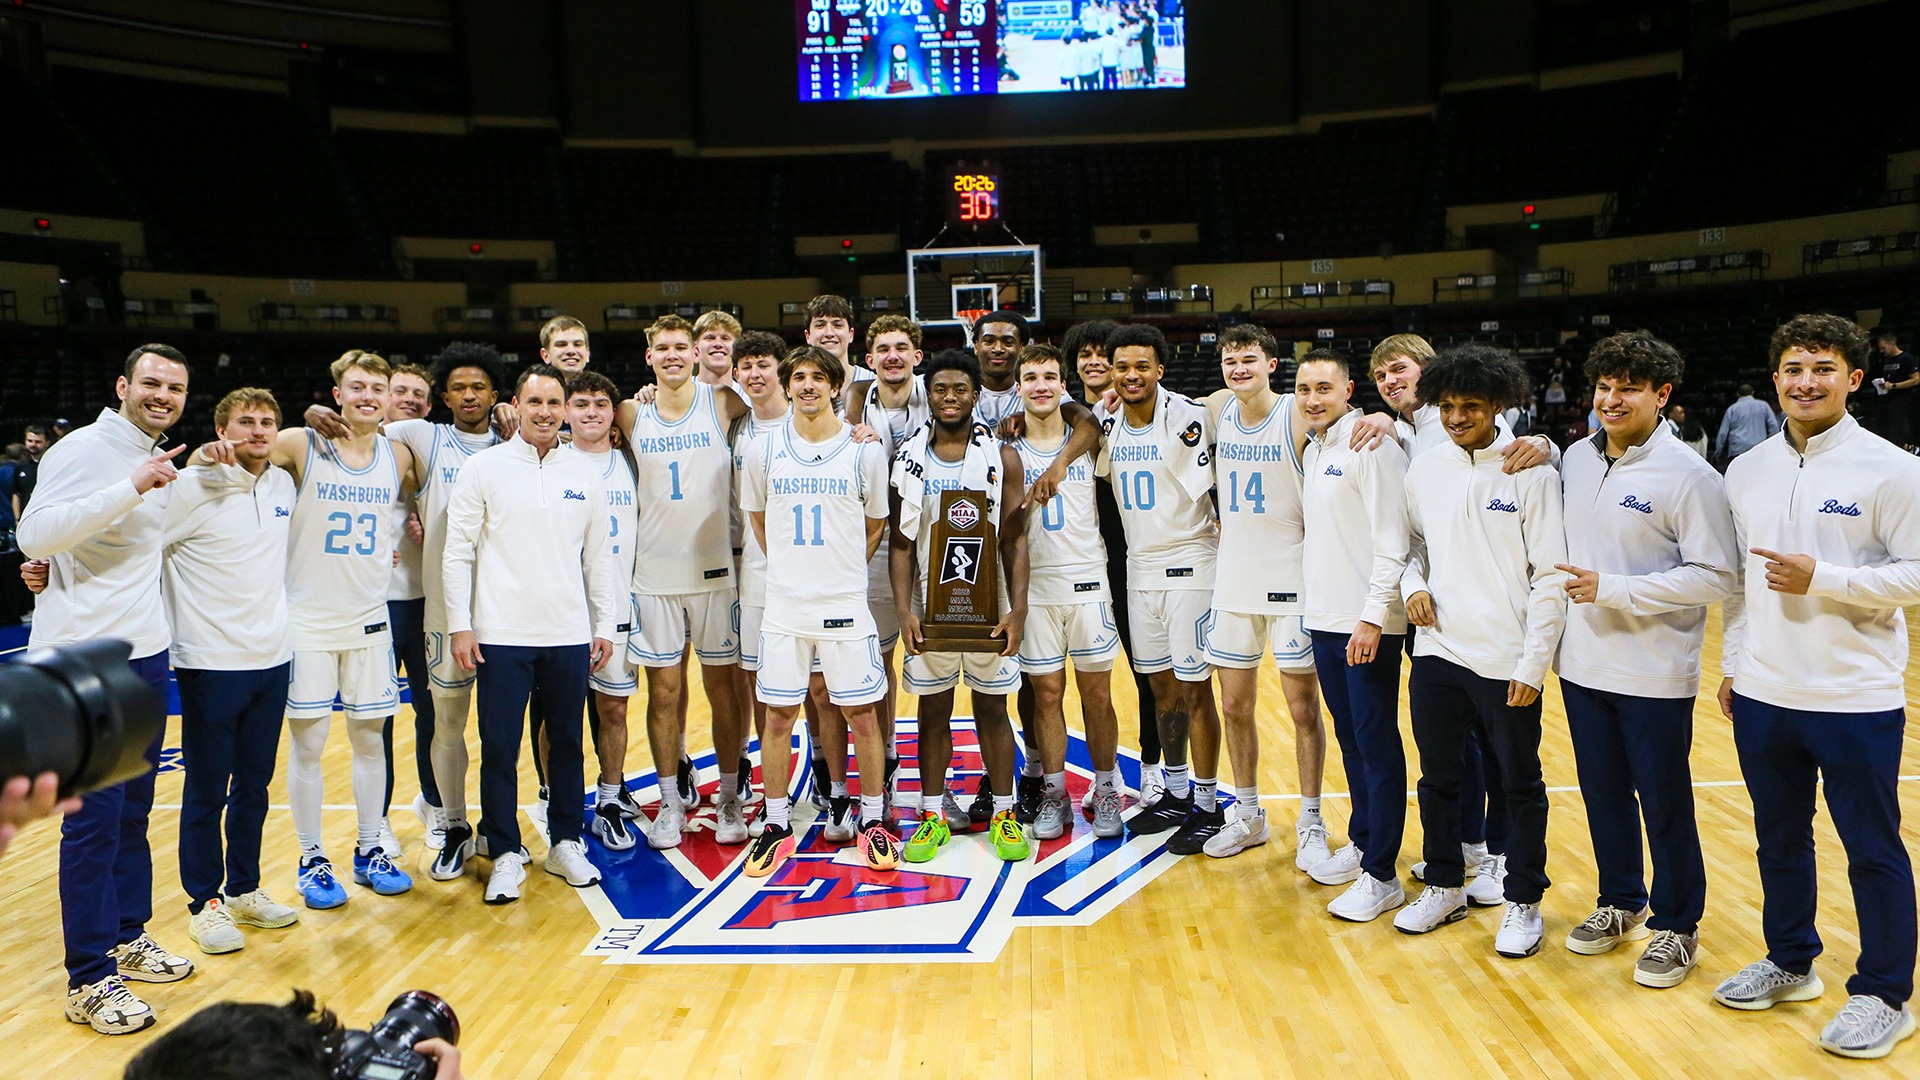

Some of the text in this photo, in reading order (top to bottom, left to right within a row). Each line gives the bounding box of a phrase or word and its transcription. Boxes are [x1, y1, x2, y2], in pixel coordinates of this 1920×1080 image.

[807, 10, 830, 33] 91
[960, 3, 986, 26] 59
[954, 175, 995, 192] 20:26
[960, 192, 992, 220] 30
[1702, 229, 1724, 243] 133
[1313, 260, 1332, 272] 135
[640, 432, 712, 454] WASHBURN
[1220, 441, 1282, 462] WASHBURN
[1110, 445, 1163, 462] ASHBUR
[1324, 464, 1343, 476] Bods
[668, 461, 683, 500] 1
[772, 478, 848, 496] WASHBURN
[1120, 470, 1156, 510] 10
[316, 482, 391, 504] WASHBURN
[562, 489, 586, 501] Bods
[1229, 470, 1266, 514] 14
[951, 510, 976, 518] MIAA
[1486, 498, 1518, 513] Bods
[1619, 494, 1654, 514] Bods
[1818, 499, 1862, 516] Bods
[324, 511, 377, 556] 23
[792, 504, 824, 546] 11
[934, 614, 986, 622] BASKETBALL
[594, 924, 645, 951] TM
